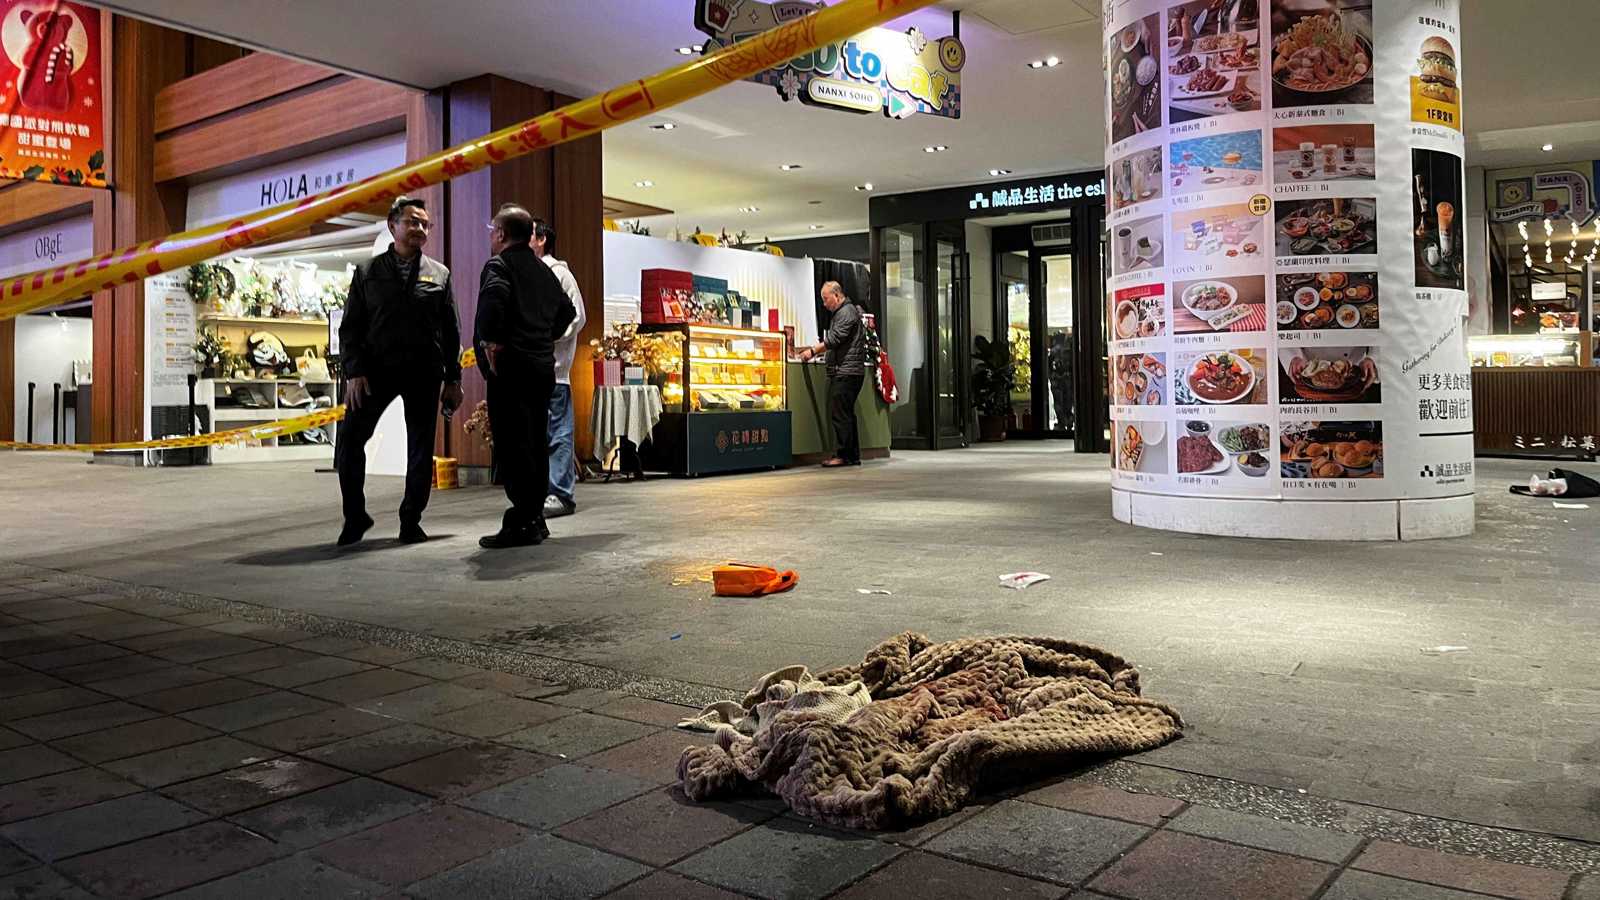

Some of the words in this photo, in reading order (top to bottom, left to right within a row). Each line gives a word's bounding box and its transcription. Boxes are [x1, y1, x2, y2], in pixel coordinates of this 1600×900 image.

[846, 41, 881, 80] to
[817, 85, 847, 99] NANXI
[849, 90, 873, 102] SOHO
[260, 173, 308, 207] HOLA
[992, 185, 1055, 207] 誠品生活
[1057, 182, 1082, 200] the
[1085, 178, 1106, 199] esl
